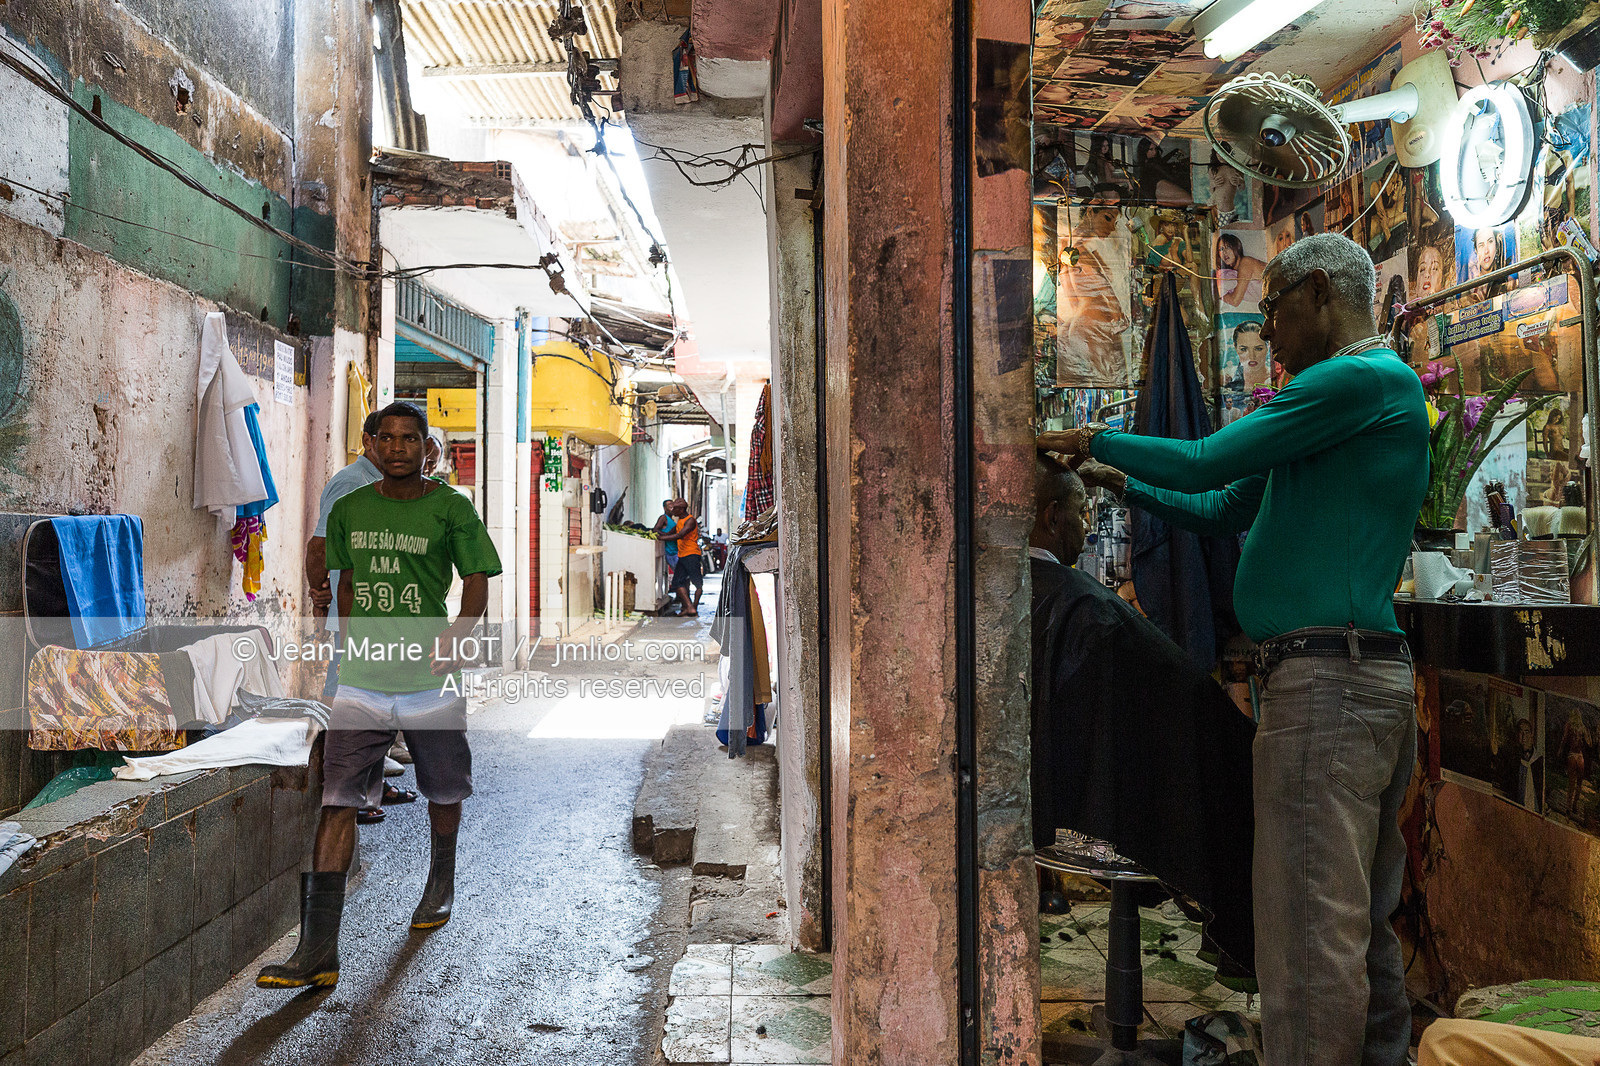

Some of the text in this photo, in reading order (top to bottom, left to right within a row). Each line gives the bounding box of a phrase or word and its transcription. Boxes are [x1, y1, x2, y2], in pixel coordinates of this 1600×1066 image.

[351, 528, 429, 556] FEIRA DE SÃO JOAQUIM
[369, 555, 400, 574] A.M.A
[354, 581, 422, 614] 594
